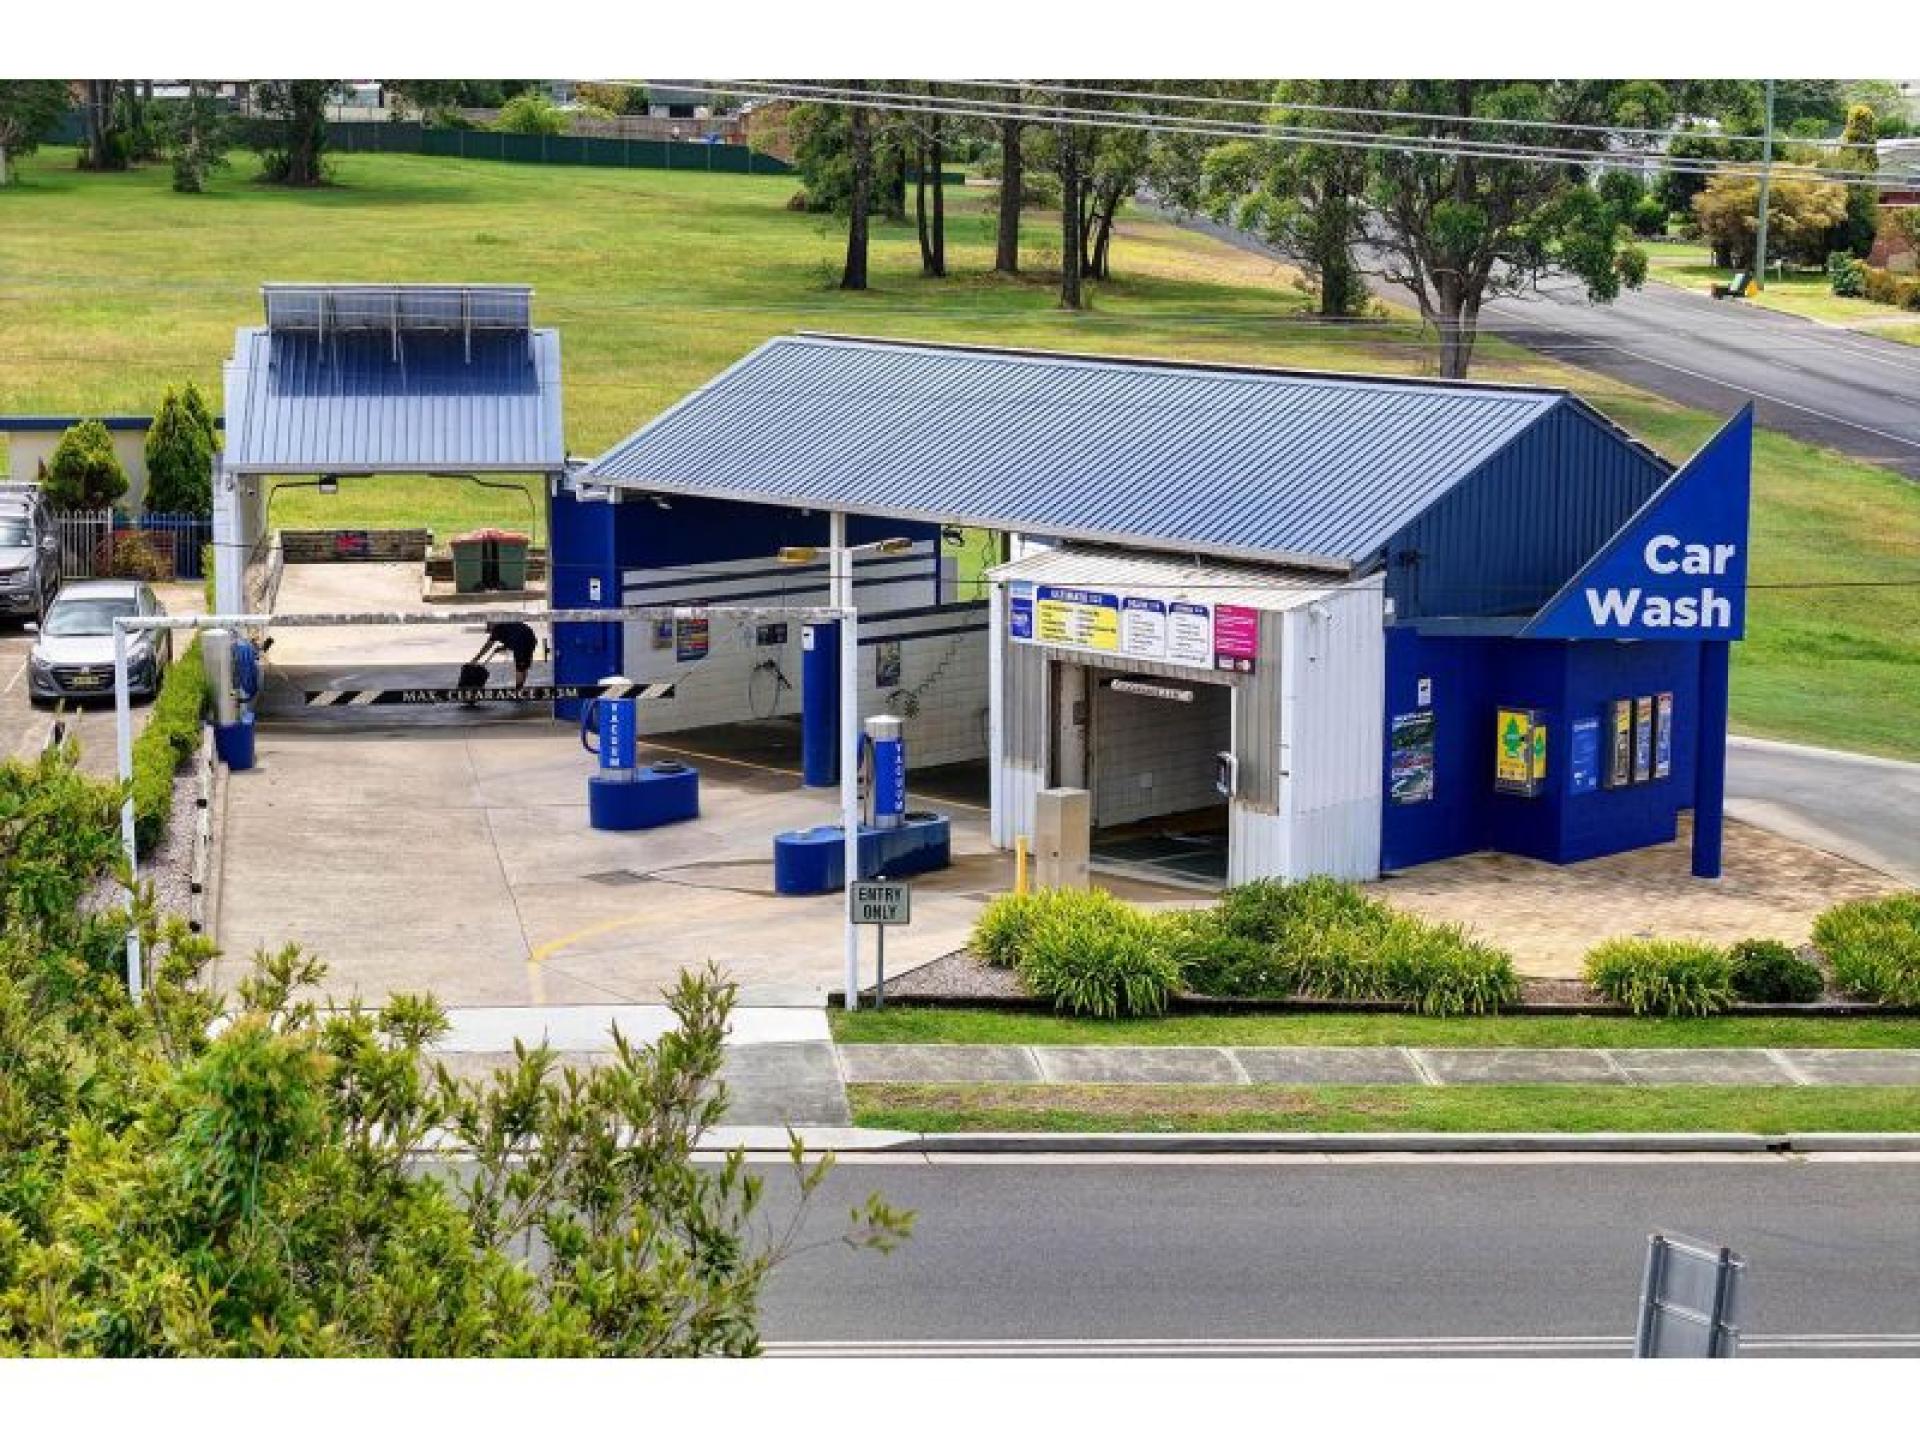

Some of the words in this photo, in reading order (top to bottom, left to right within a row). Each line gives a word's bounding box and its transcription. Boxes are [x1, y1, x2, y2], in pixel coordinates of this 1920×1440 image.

[1644, 534, 1735, 575] Car
[1585, 587, 1731, 628] Wash
[447, 688, 537, 700] CLEARANCE
[858, 887, 903, 901] ENTRY
[863, 904, 898, 919] ONLY
